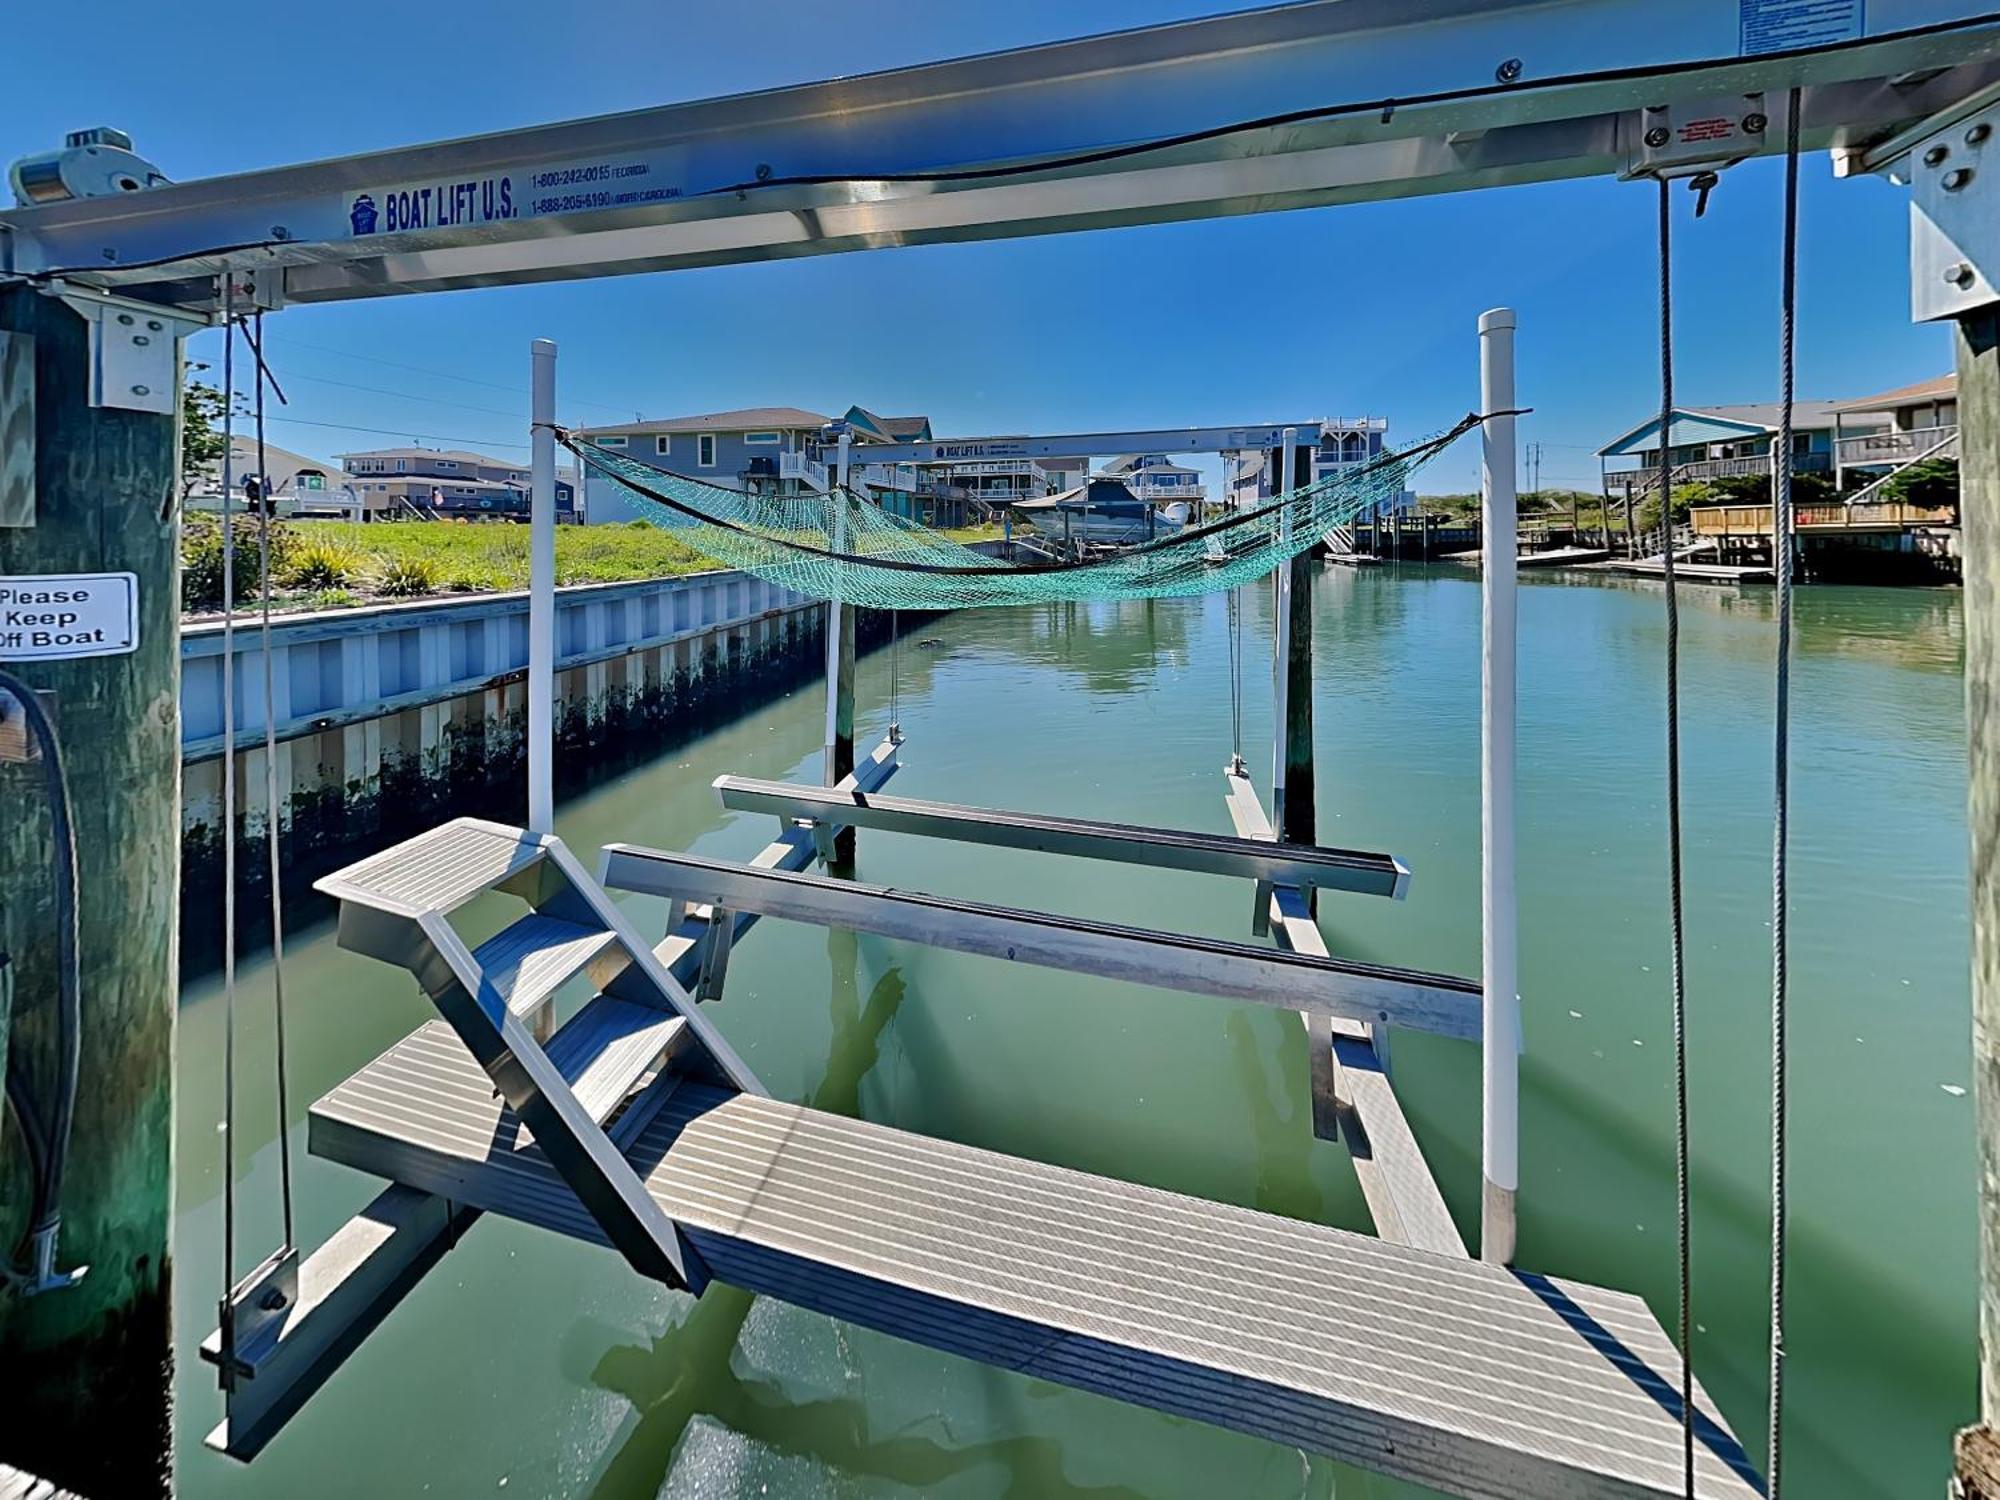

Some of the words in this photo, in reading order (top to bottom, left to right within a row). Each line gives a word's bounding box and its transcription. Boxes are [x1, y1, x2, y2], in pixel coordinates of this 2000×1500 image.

[387, 189, 431, 232] BOAT
[437, 182, 477, 226] LIFT
[482, 177, 518, 221] U.S.
[0, 589, 89, 605] Please
[6, 611, 77, 628] Keep
[32, 629, 104, 647] Boat
